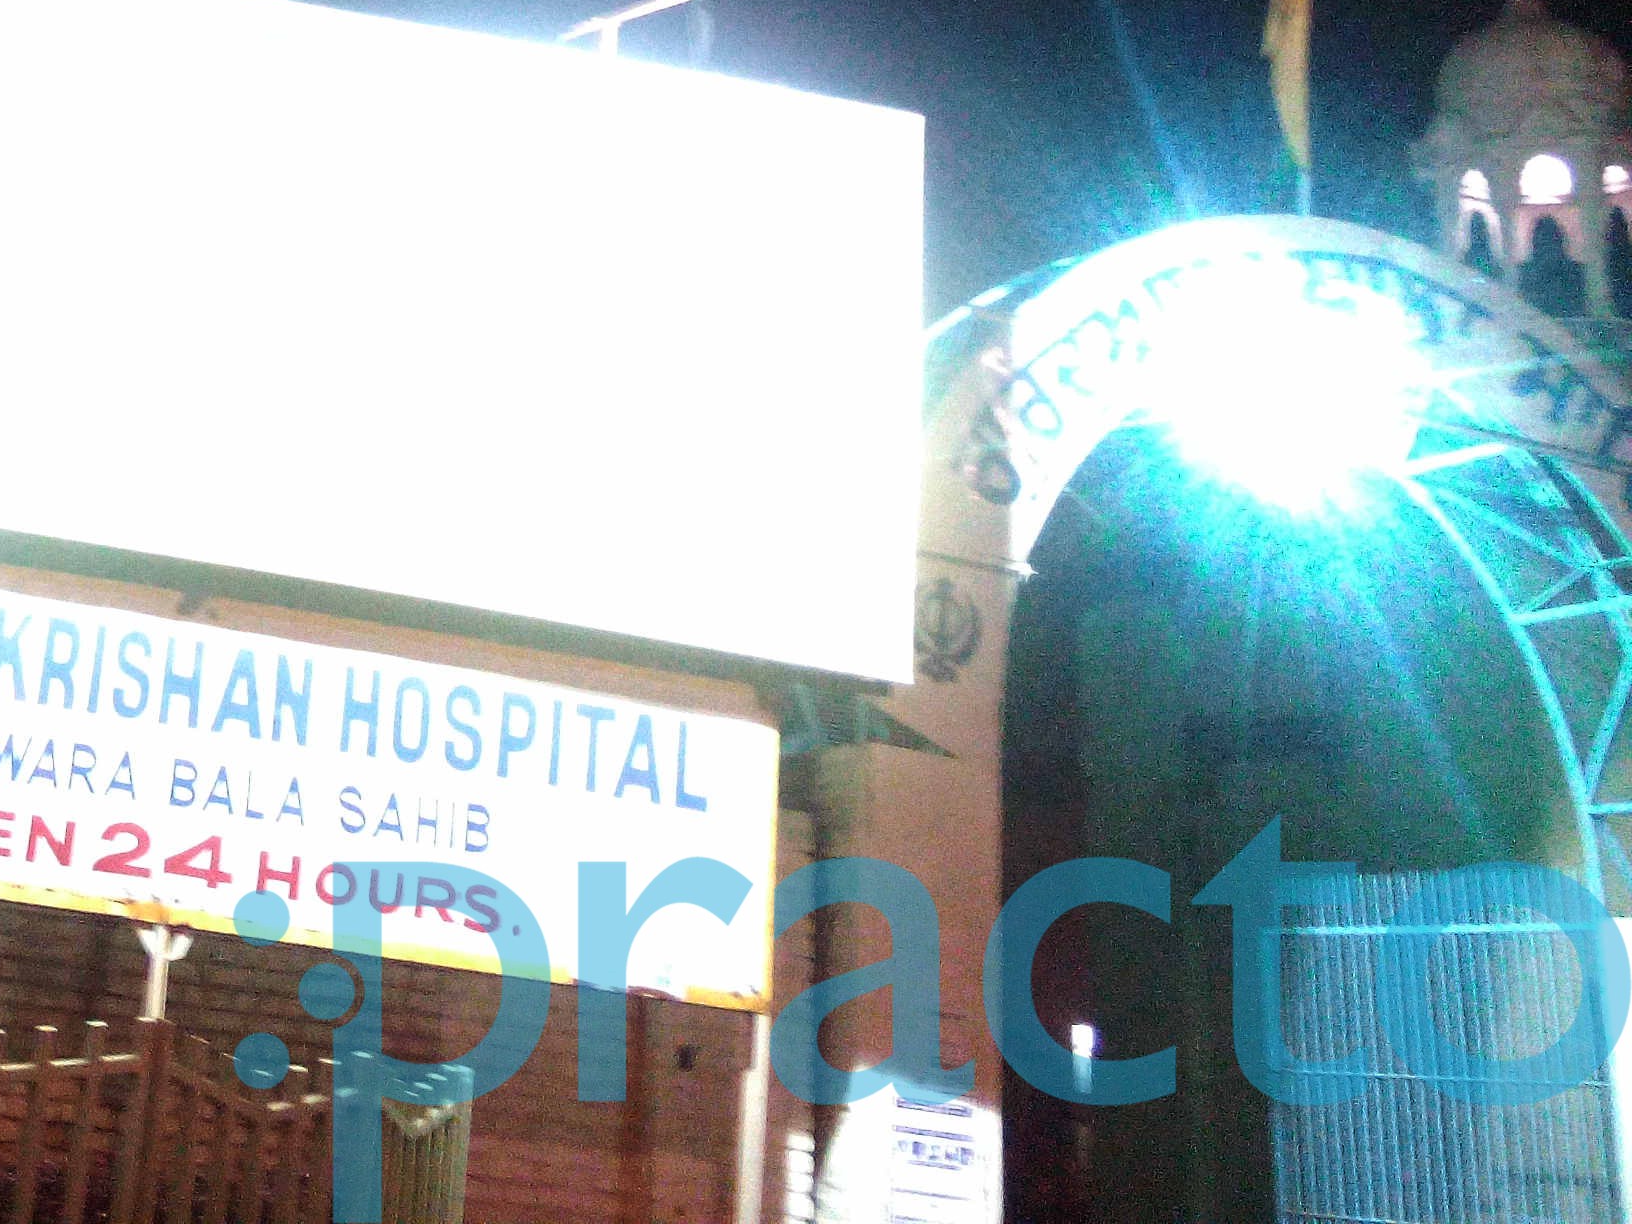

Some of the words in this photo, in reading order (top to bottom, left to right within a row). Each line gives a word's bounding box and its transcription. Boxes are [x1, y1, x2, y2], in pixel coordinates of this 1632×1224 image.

[340, 667, 708, 812] HOSPITAL
[168, 759, 305, 826] BALA
[339, 786, 491, 853] SAHIB
[93, 822, 233, 890] 24
[255, 851, 521, 937] HOURS.
